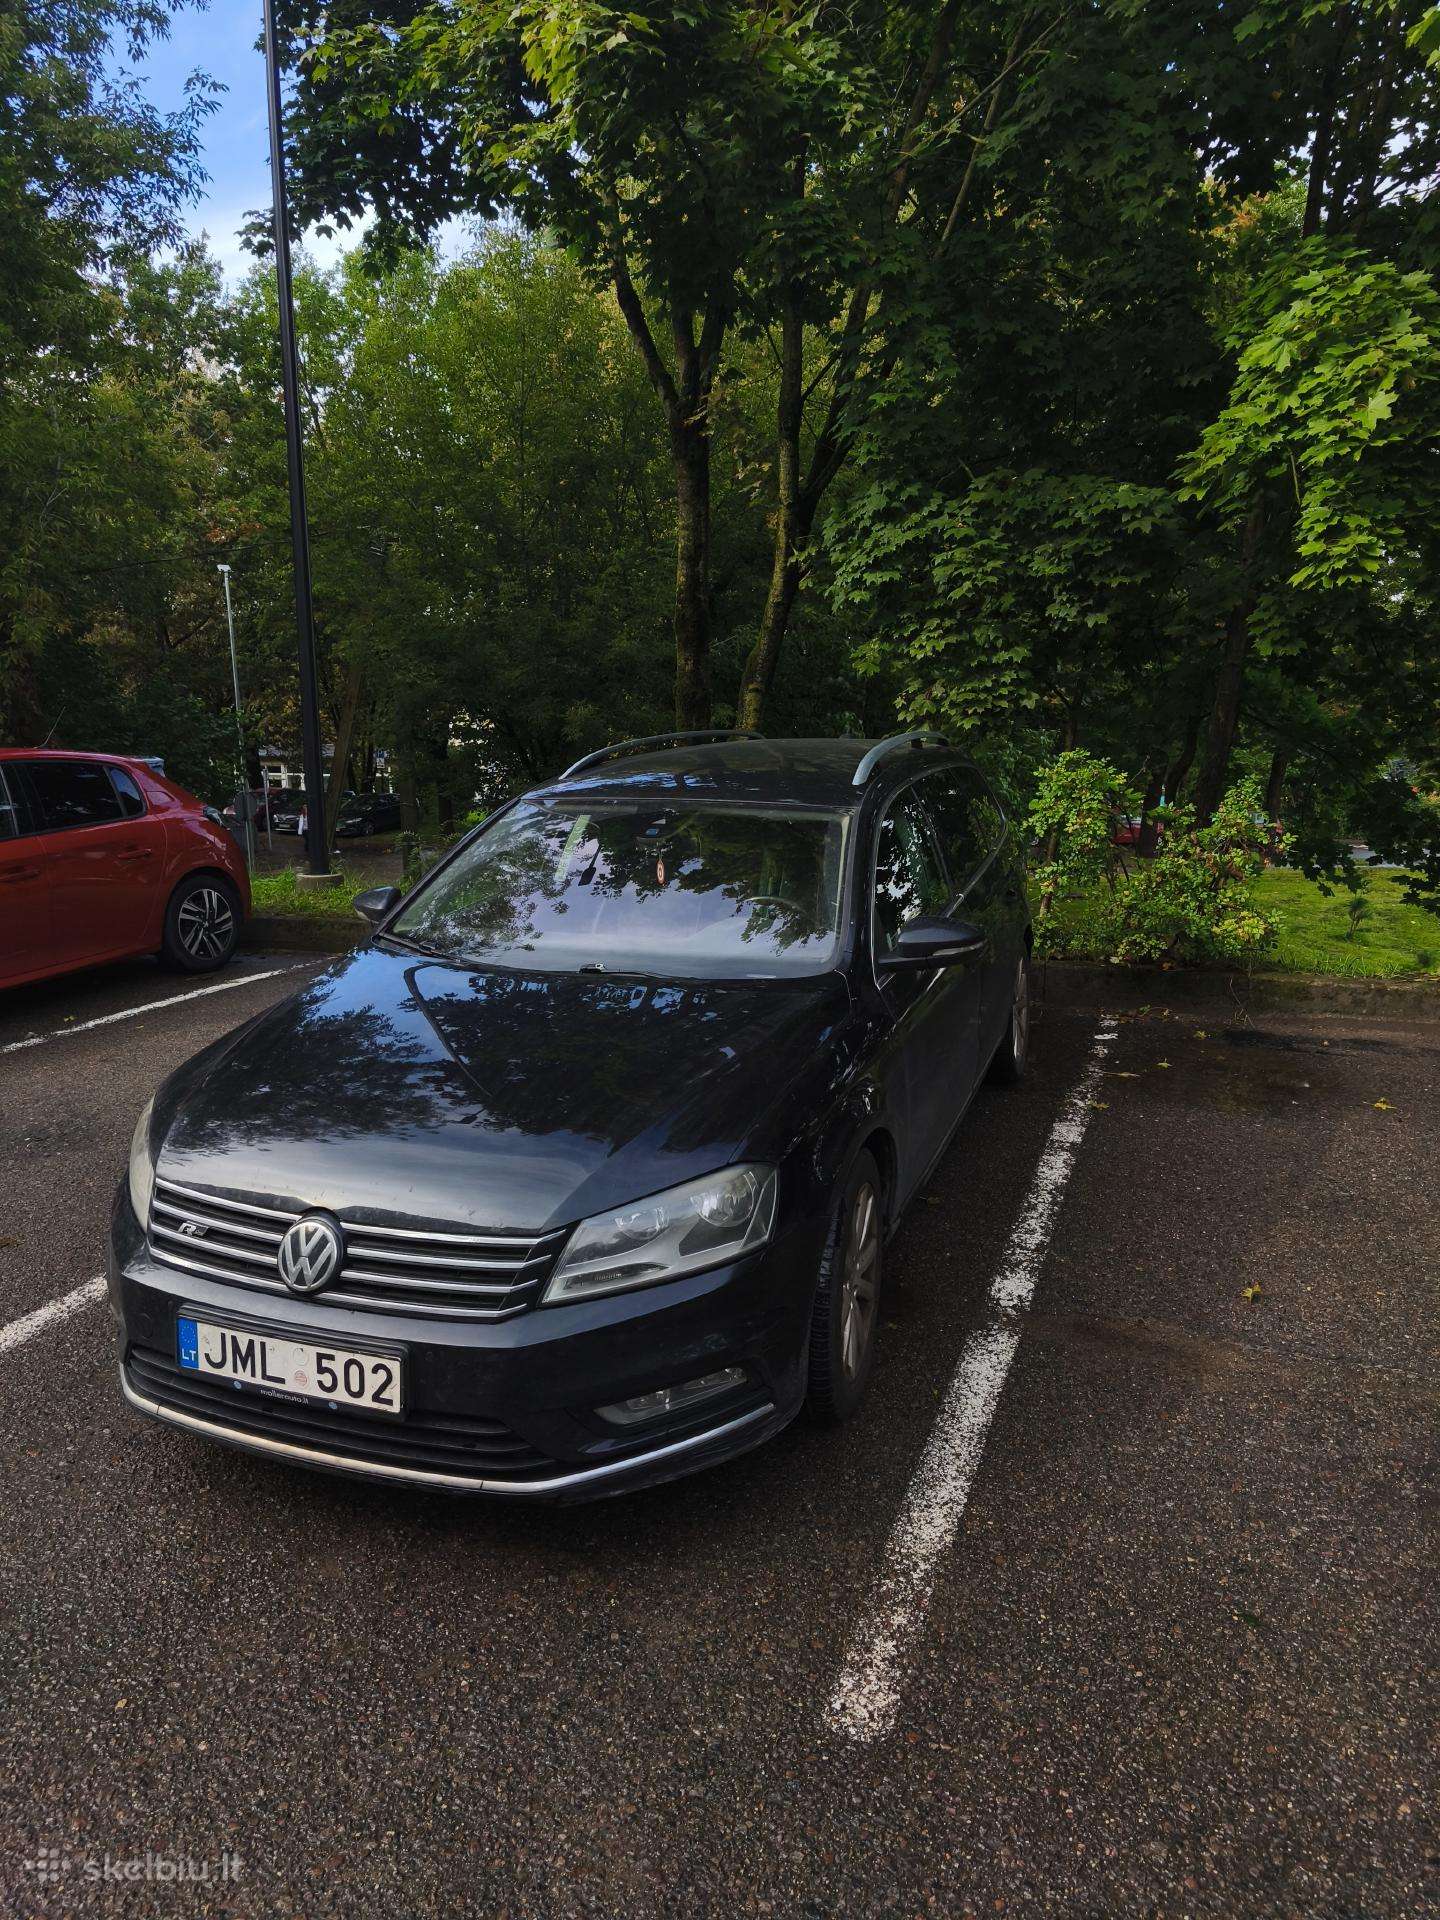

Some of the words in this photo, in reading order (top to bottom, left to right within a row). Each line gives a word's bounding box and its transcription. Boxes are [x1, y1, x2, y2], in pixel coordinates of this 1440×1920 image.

[181, 1349, 196, 1361] LT
[204, 1332, 286, 1385] JML
[315, 1351, 394, 1407] 502
